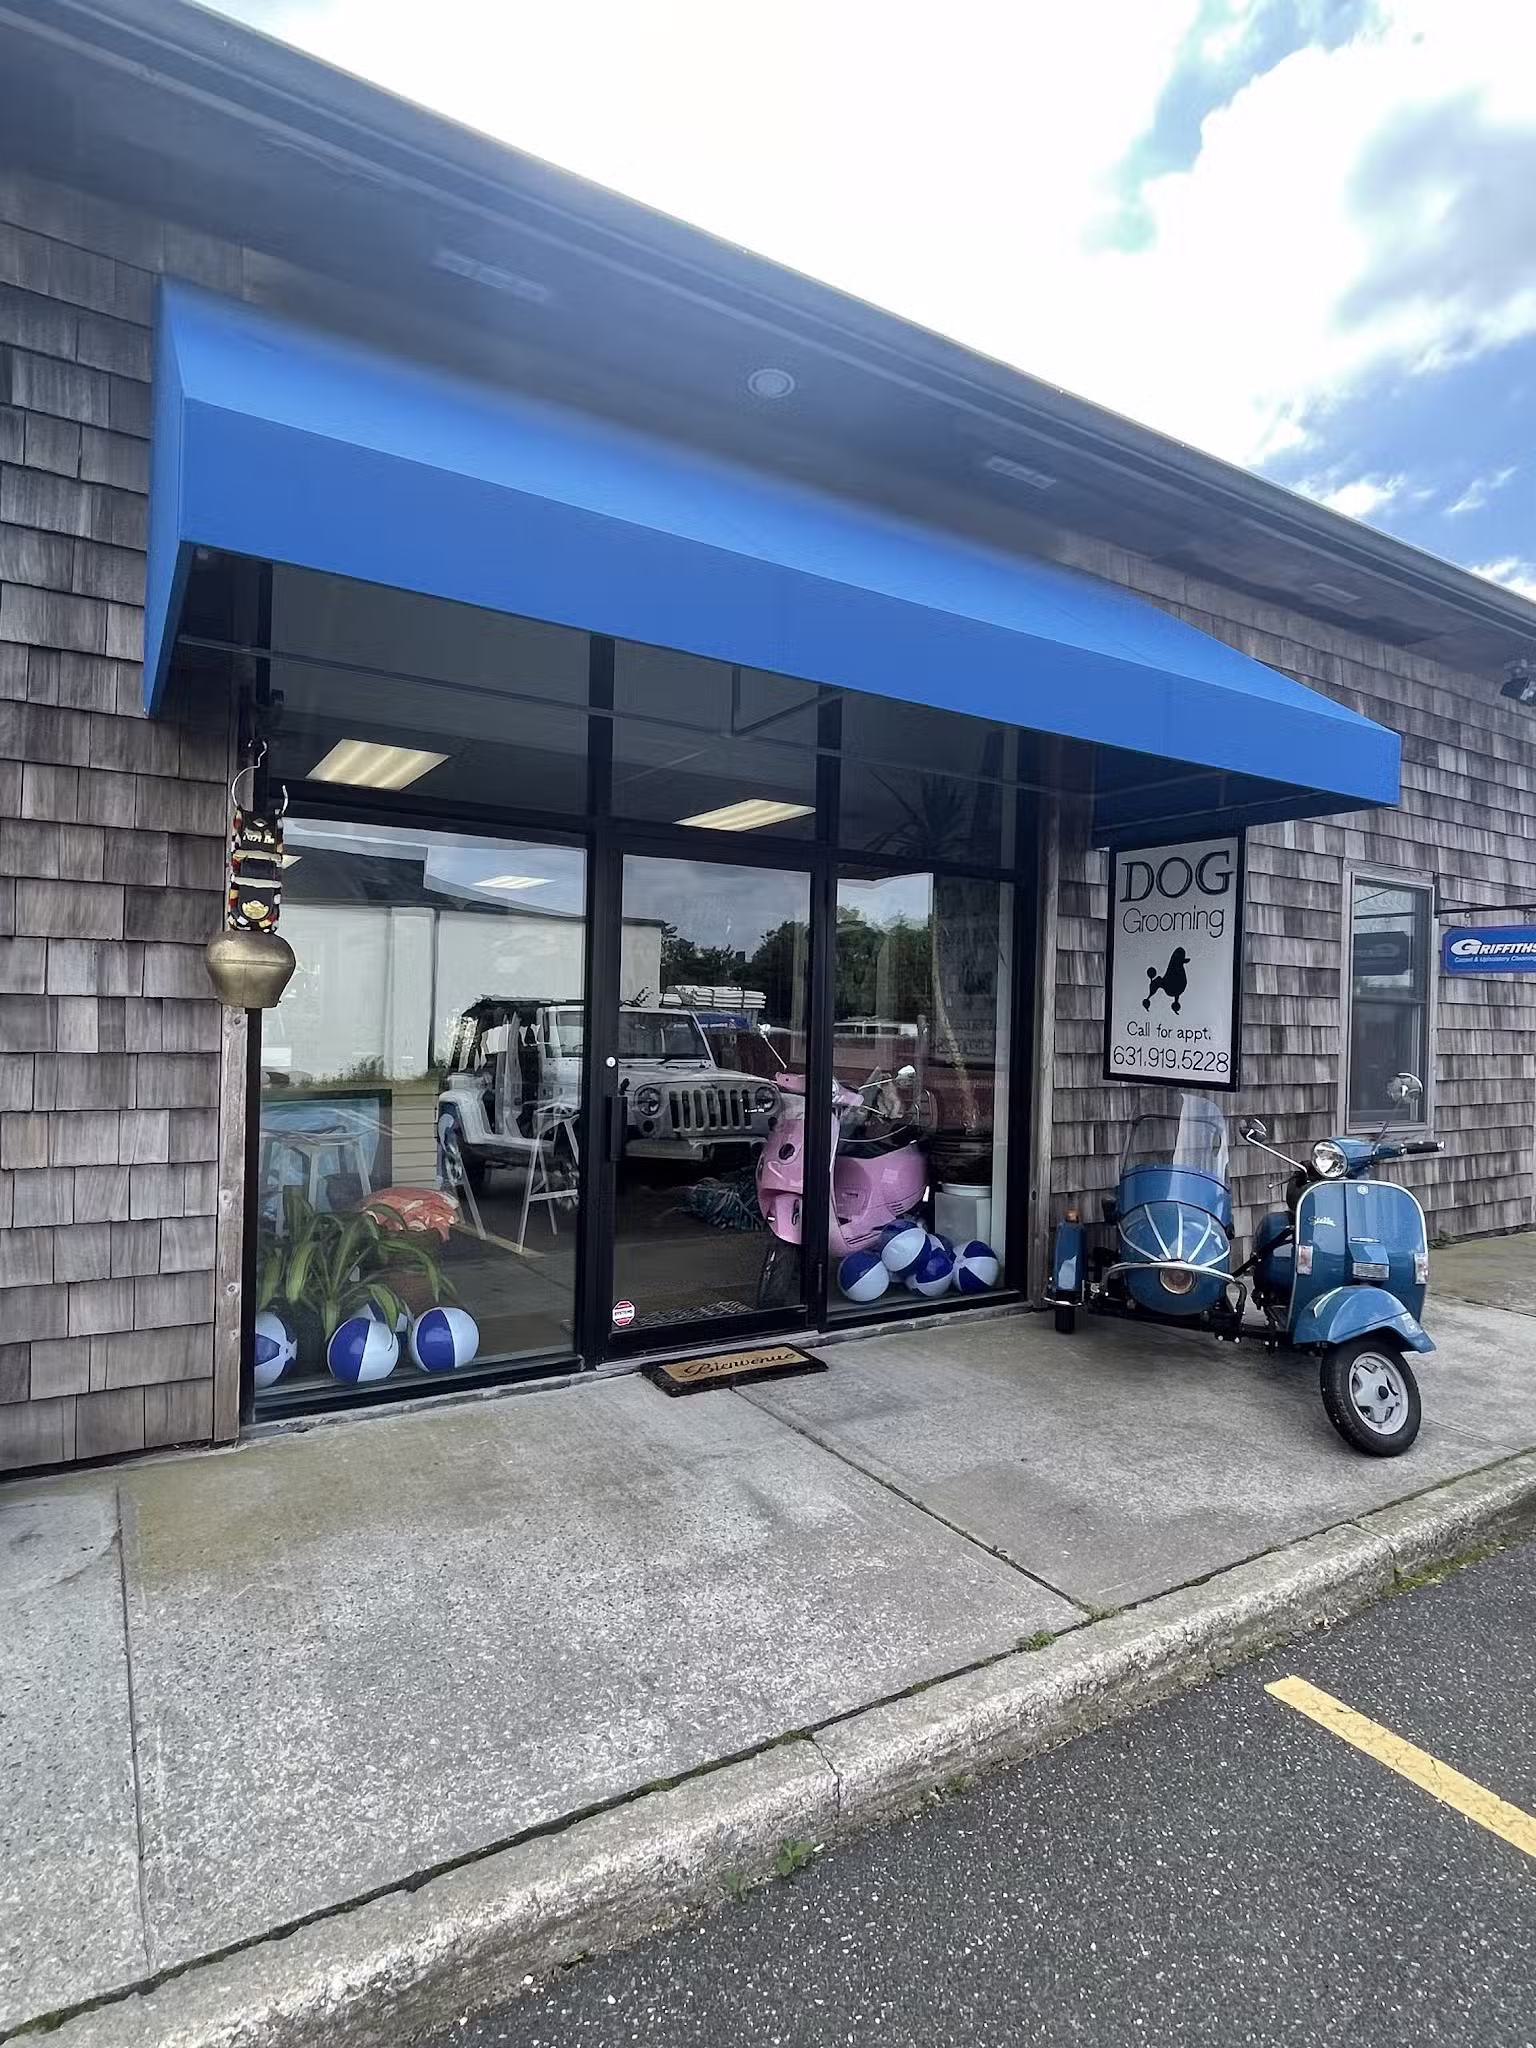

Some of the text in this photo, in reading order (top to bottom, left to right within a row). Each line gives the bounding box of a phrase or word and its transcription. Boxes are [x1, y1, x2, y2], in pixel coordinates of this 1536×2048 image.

[1119, 850, 1236, 903] DOG
[1122, 904, 1225, 939] Grooming
[1126, 1020, 1212, 1044] Call for appt.
[1113, 1045, 1229, 1073] 631.919.5228
[678, 1352, 796, 1378] Bienvenue
